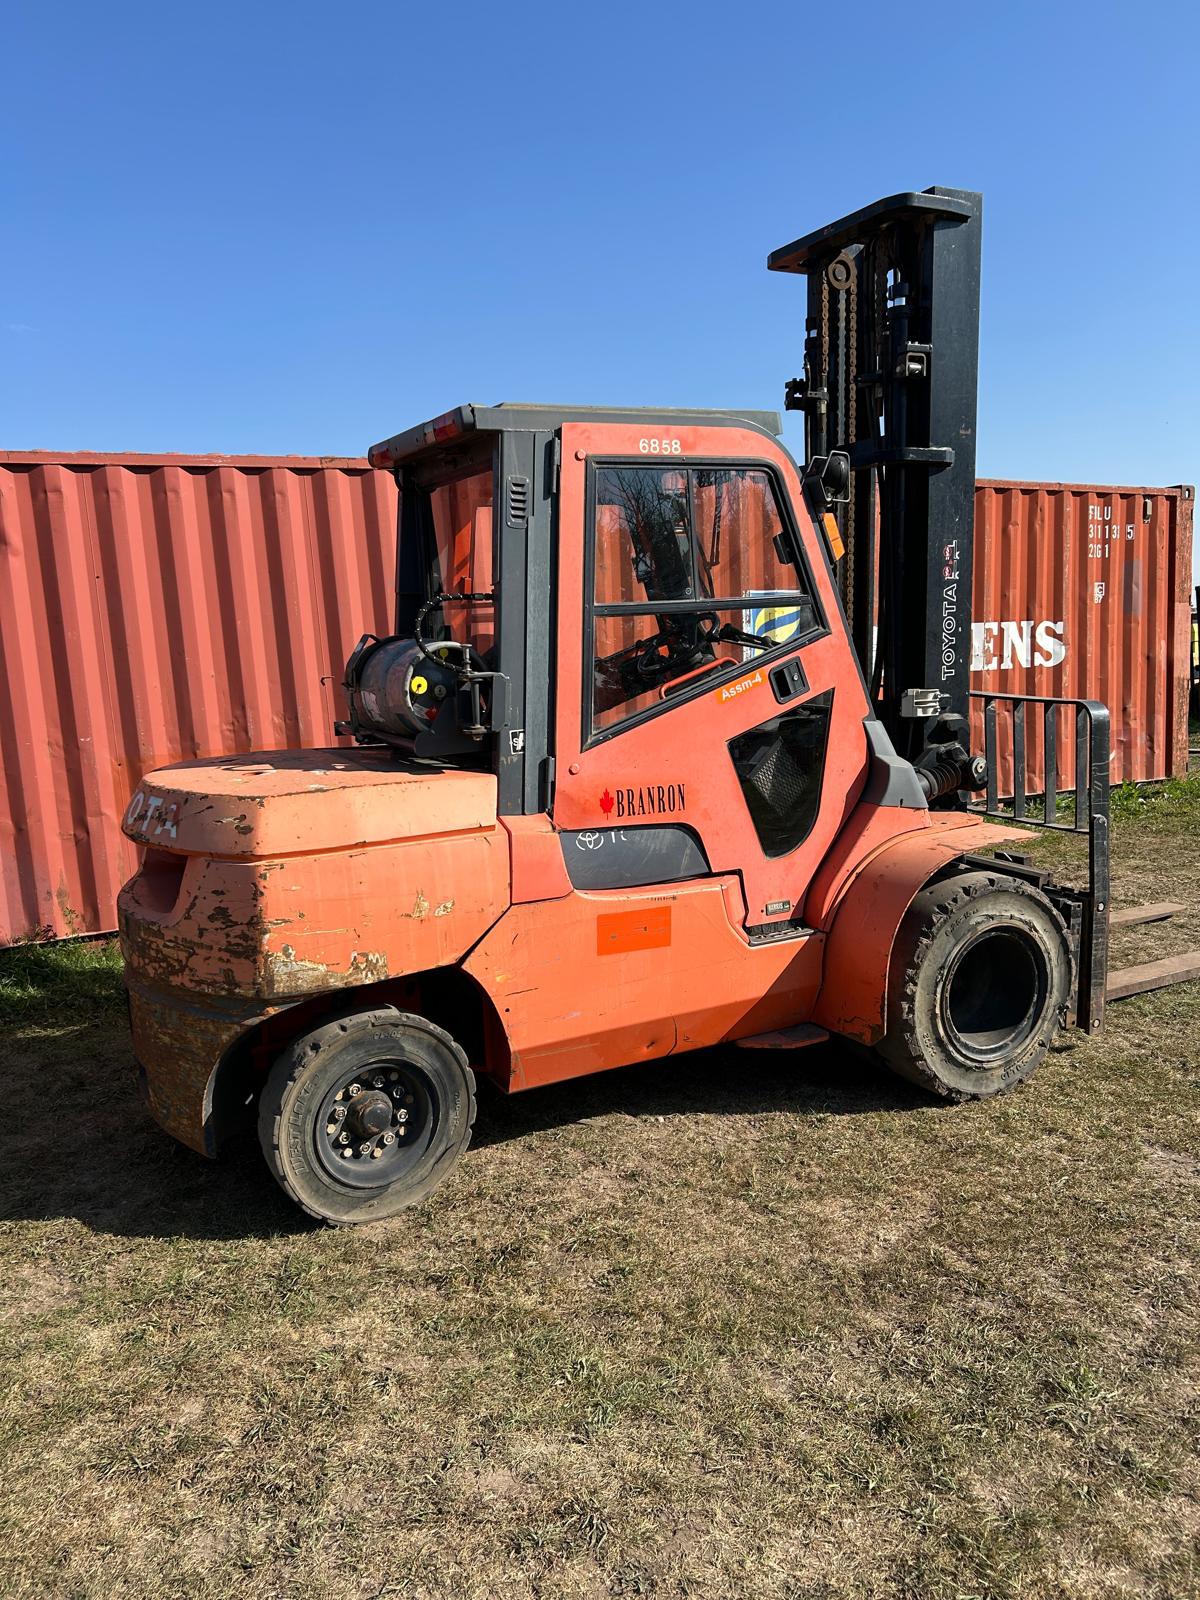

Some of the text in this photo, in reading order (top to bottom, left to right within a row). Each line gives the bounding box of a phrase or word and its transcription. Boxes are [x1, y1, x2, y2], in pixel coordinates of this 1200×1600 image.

[639, 439, 681, 454] 6858
[1088, 505, 1111, 520] FILU
[942, 583, 957, 680] TOYOTA
[721, 671, 762, 701] Assm-4
[616, 784, 686, 817] BRANRON
